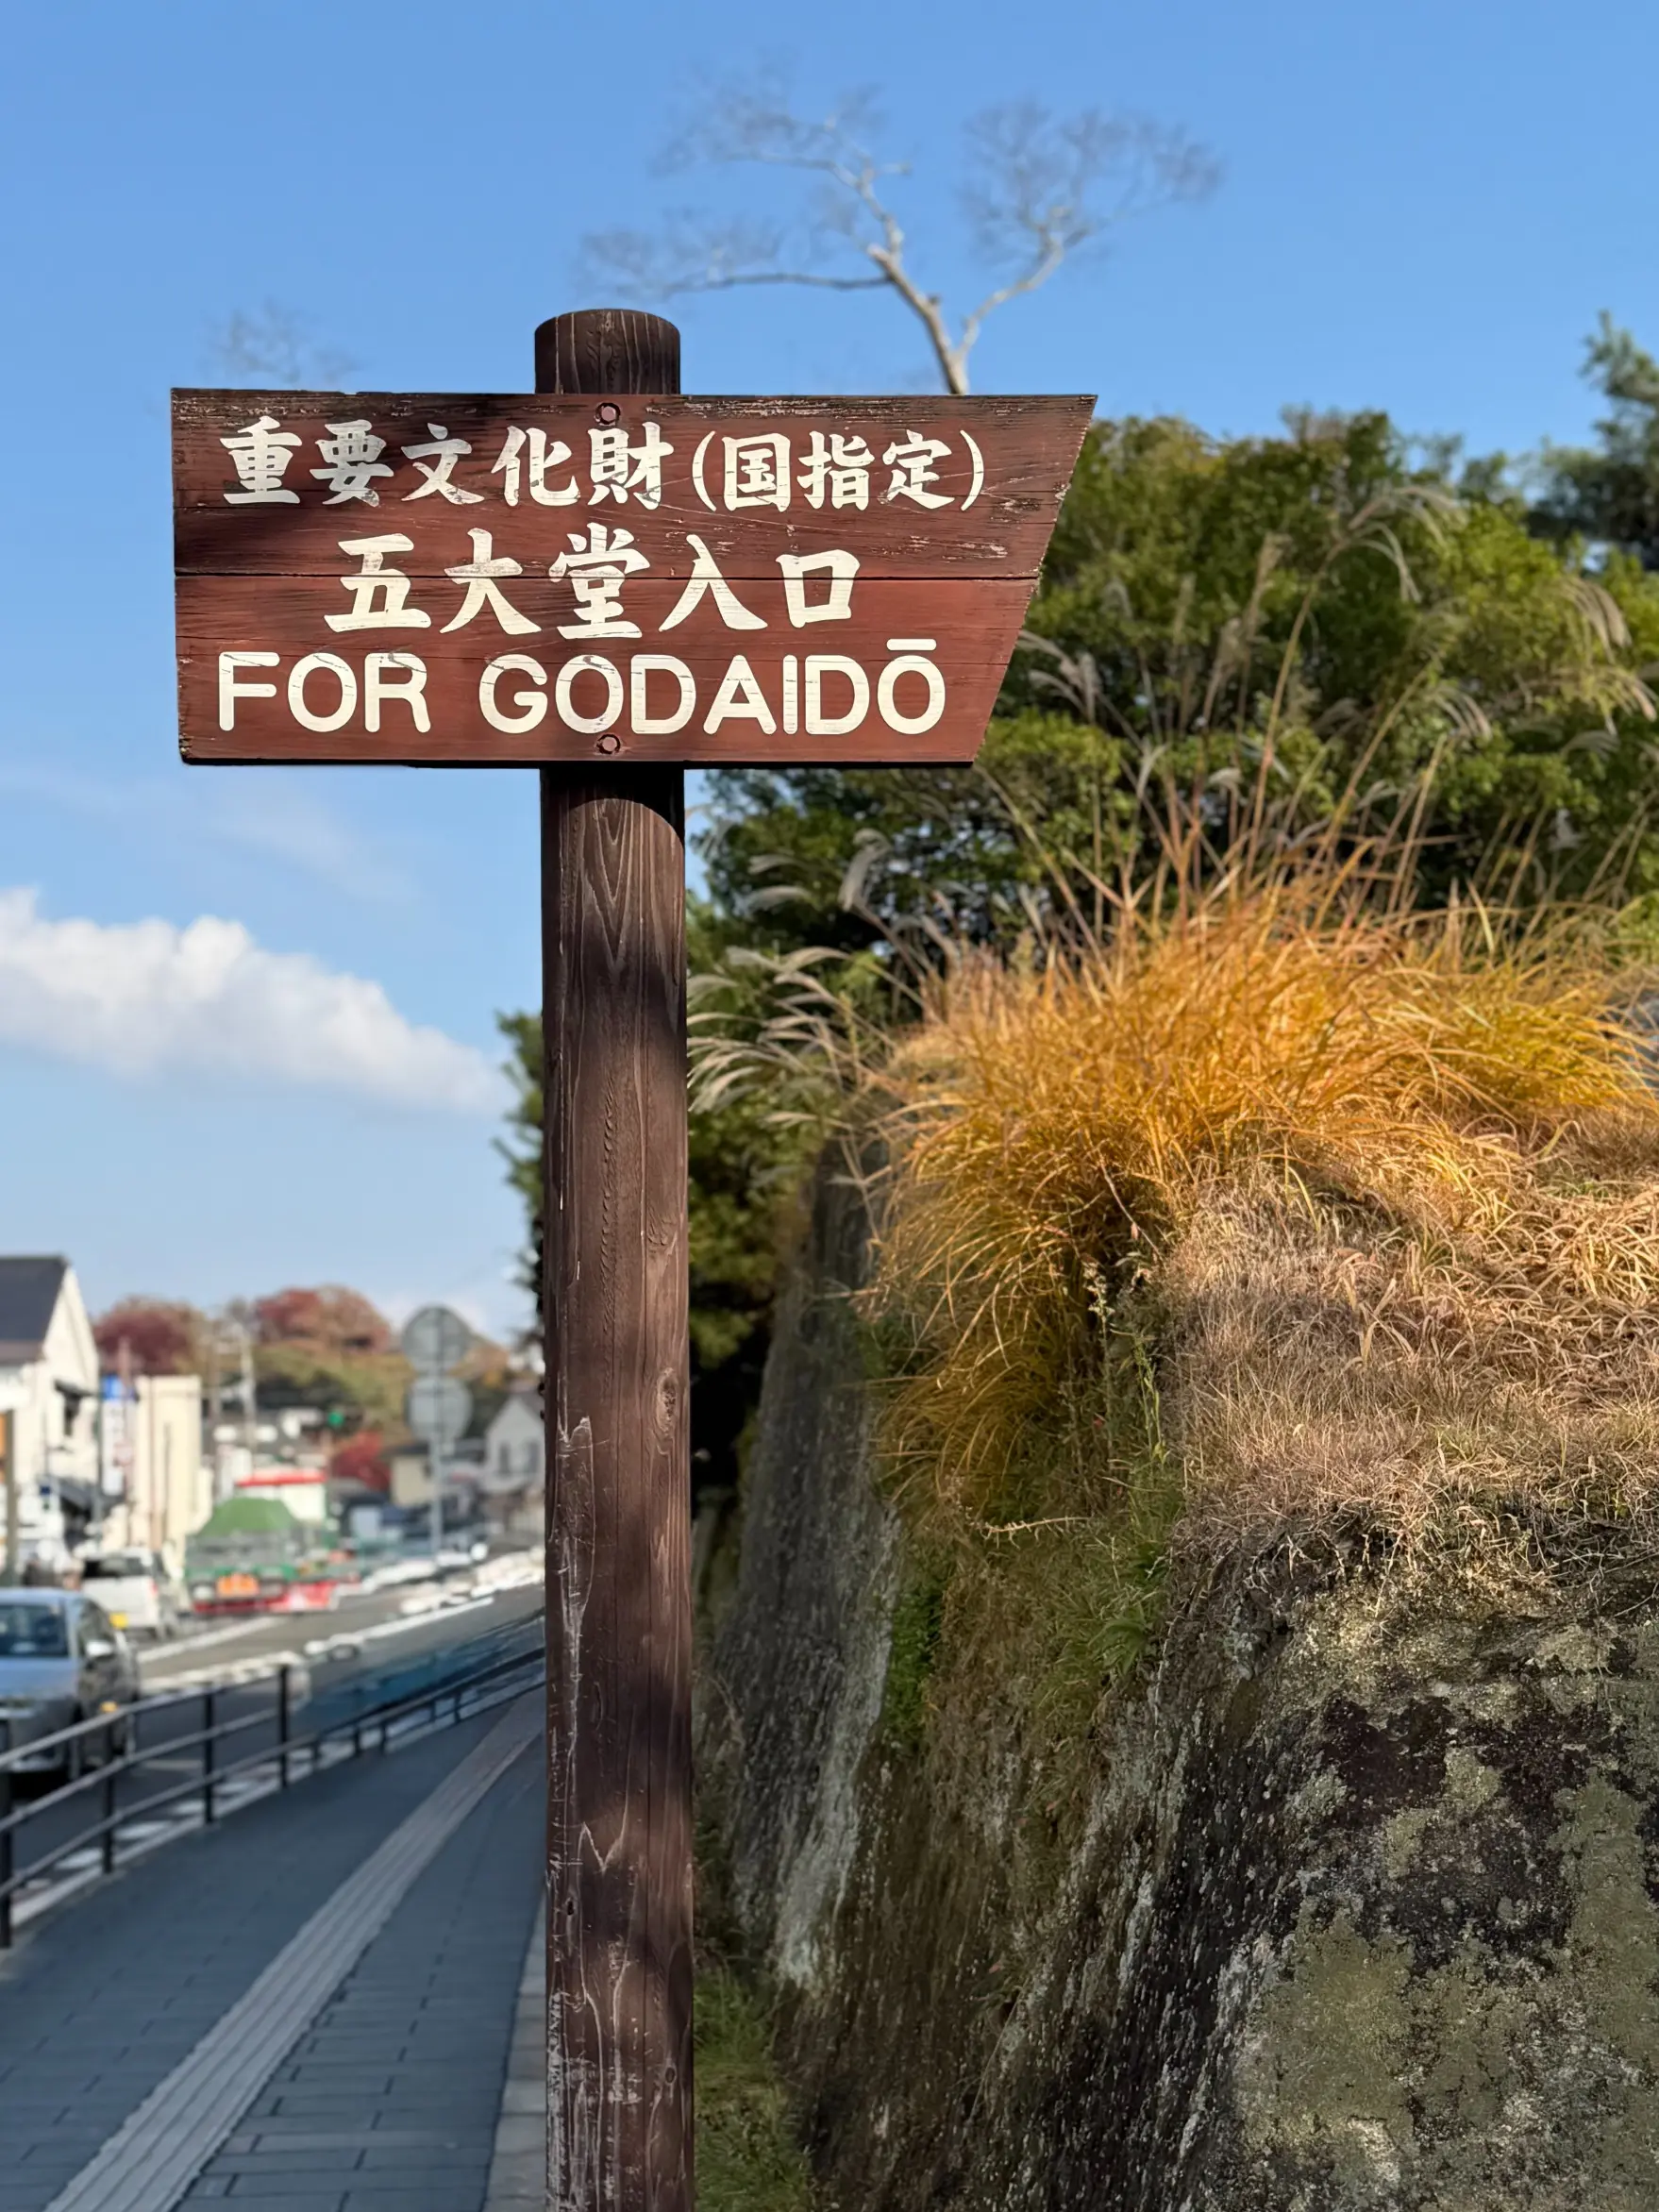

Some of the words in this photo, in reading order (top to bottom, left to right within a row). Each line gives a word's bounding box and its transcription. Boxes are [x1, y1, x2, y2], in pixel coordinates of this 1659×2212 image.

[218, 415, 984, 512] 重要文化財(国指定)
[324, 522, 861, 640] 五大堂入口
[217, 651, 432, 733] FOR
[478, 638, 947, 735] GODAIDŌ
